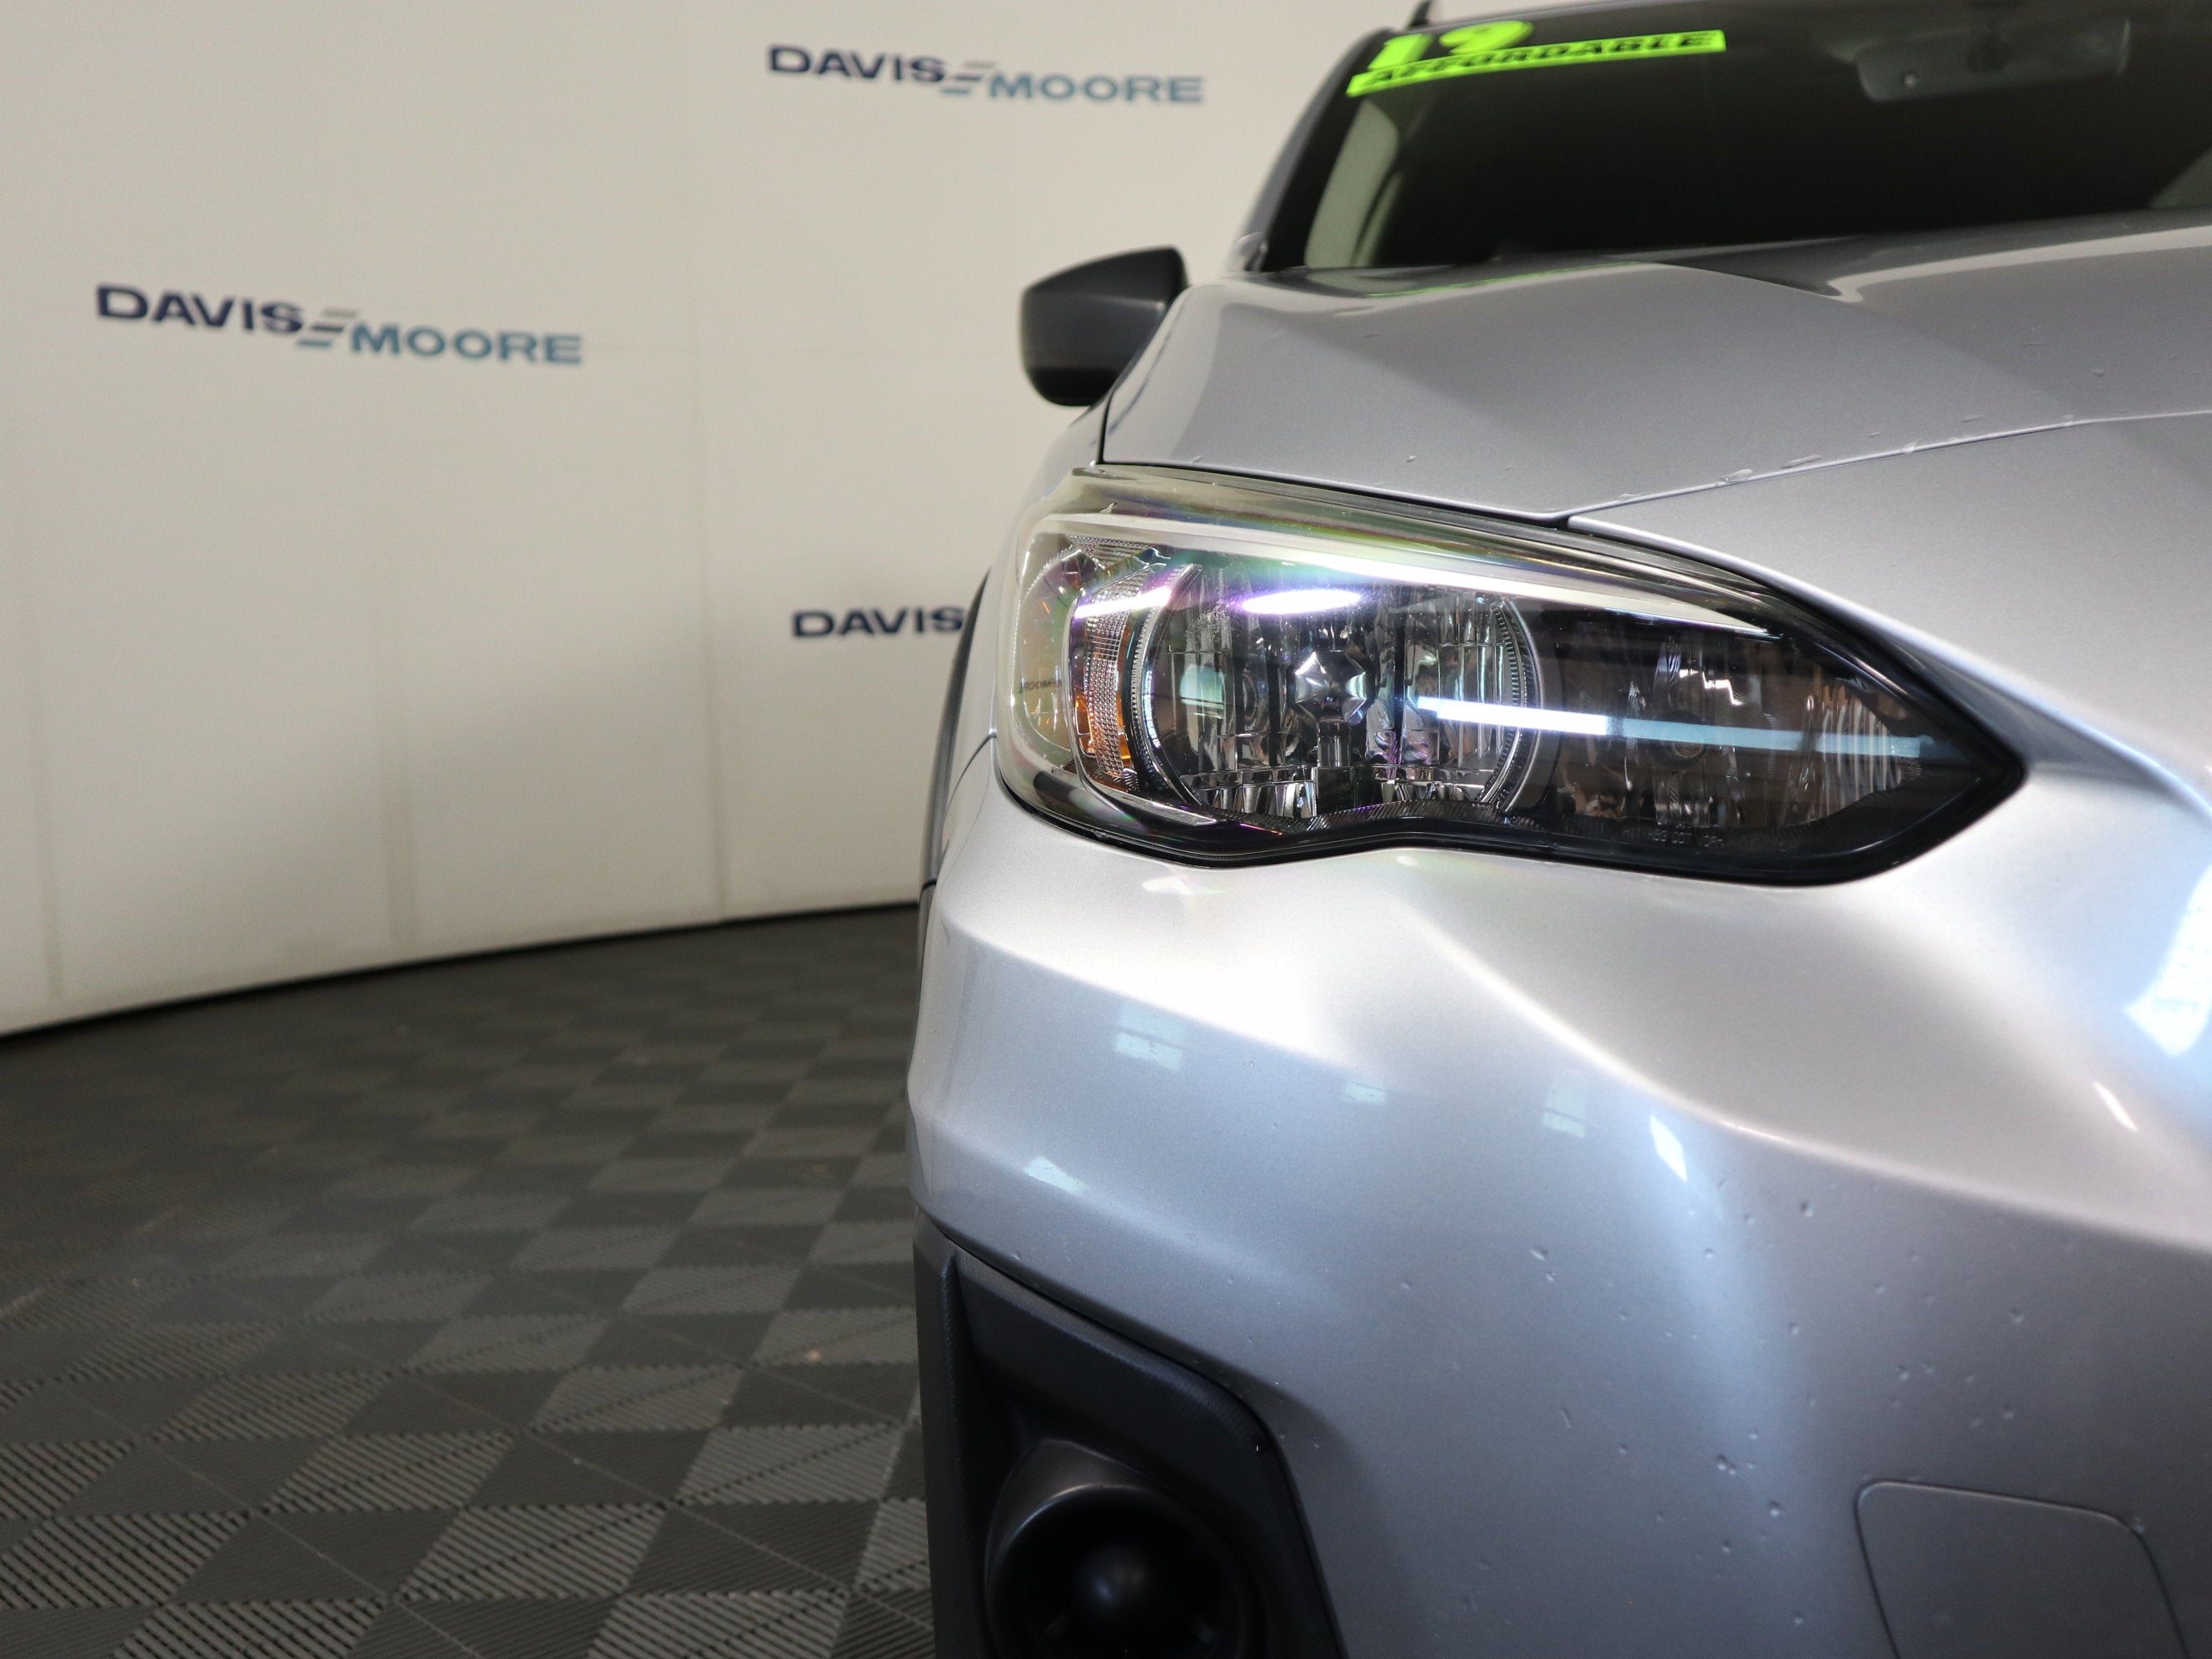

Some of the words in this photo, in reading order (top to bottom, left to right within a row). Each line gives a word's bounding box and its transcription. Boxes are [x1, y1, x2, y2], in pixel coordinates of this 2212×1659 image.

[1367, 20, 1534, 70] 19
[767, 43, 947, 84] DAVIS
[989, 72, 1203, 104] MOORE
[94, 282, 304, 335] DAVIS
[348, 321, 583, 366] MOORE
[791, 605, 965, 638] DAVIS
